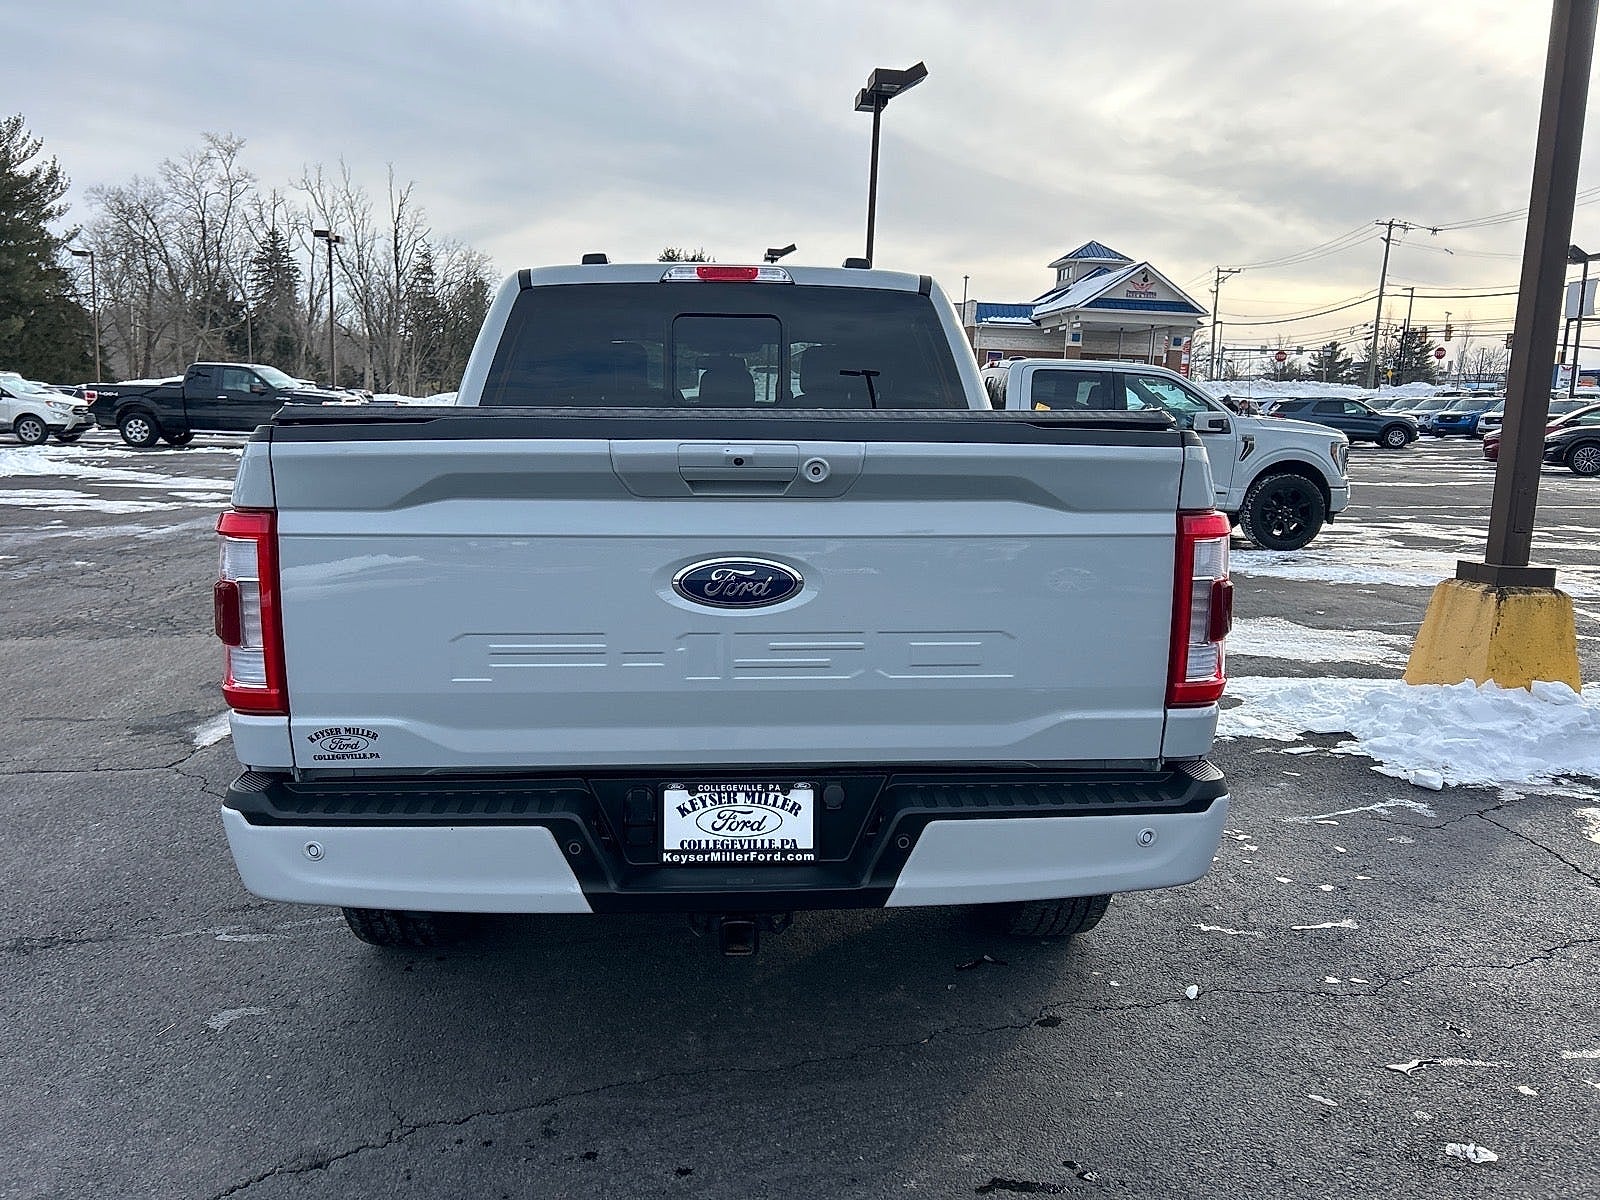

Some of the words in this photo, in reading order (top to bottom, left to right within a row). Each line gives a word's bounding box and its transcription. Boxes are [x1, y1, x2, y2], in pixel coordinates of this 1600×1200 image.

[704, 568, 772, 596] Ford
[449, 631, 1016, 683] F-150
[307, 727, 342, 744] KEYSER
[344, 727, 379, 741] MILLER
[328, 737, 361, 750] Ford
[698, 784, 765, 792] COLLEGEVILLE,
[676, 791, 738, 818] KEYSER
[744, 791, 803, 818] MILLER
[711, 809, 768, 832] Ford
[662, 851, 815, 864] KeyserMillerFord.com
